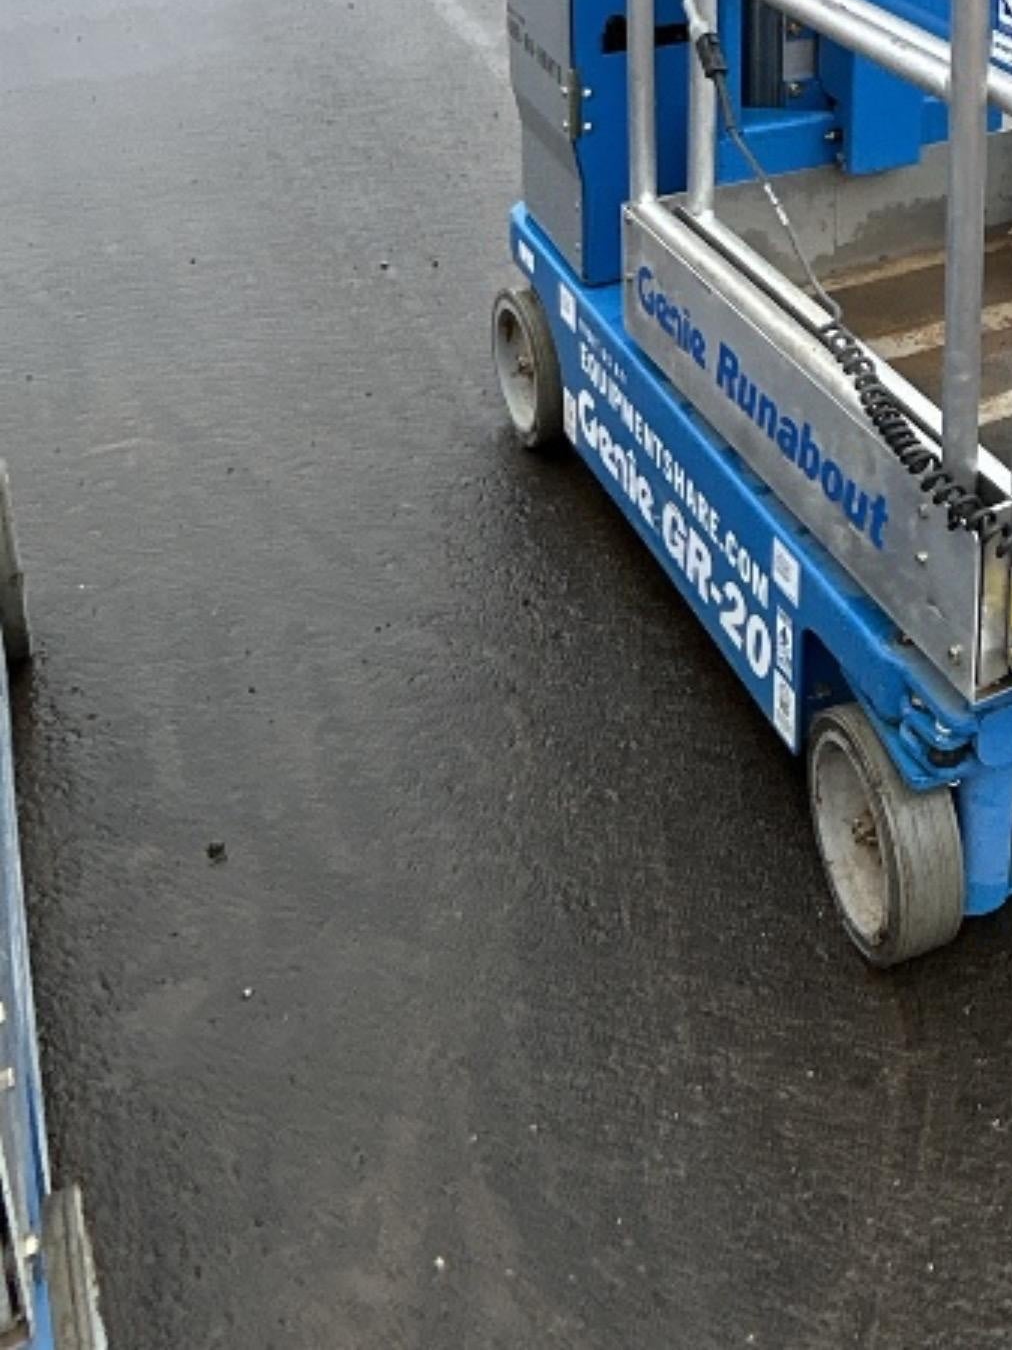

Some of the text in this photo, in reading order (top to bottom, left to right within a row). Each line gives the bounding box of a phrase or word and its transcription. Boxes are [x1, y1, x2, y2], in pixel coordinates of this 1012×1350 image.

[577, 387, 656, 531] Genie
[661, 512, 773, 680] GR-20
[636, 265, 706, 370] Genie
[716, 347, 890, 549] Runabout
